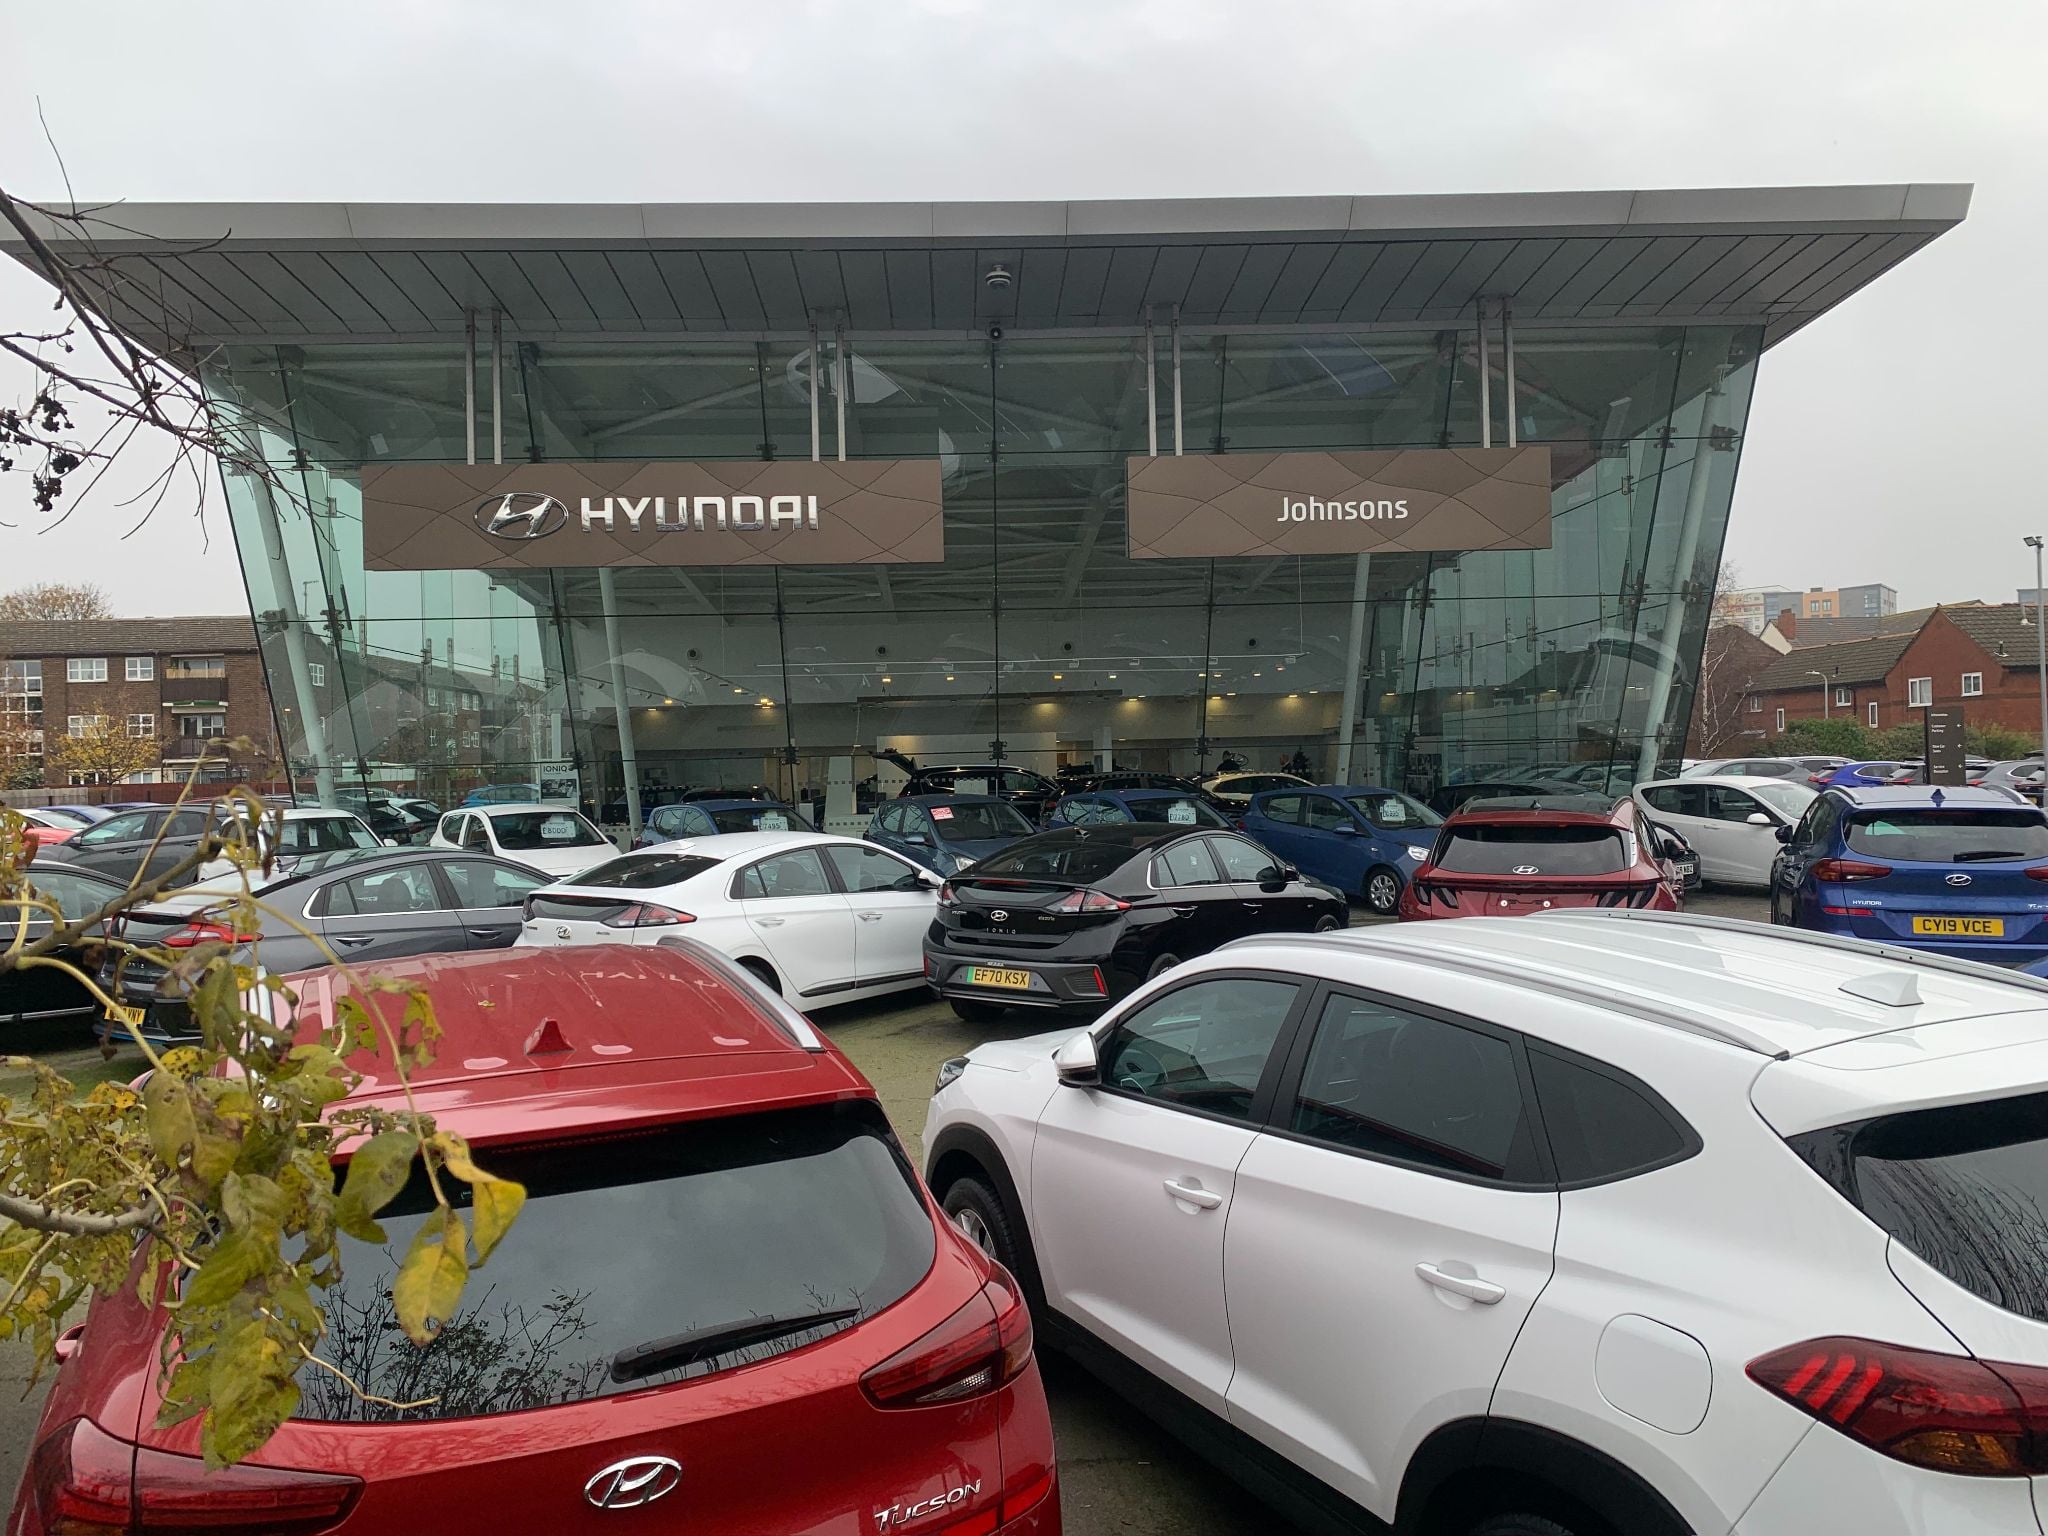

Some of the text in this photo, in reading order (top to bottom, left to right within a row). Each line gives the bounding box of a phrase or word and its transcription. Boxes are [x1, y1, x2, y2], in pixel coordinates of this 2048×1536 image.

[580, 495, 818, 533] HYUNDAI
[1277, 496, 1409, 522] Johnsons
[543, 765, 568, 773] IONIQ
[986, 927, 1017, 935] IONIQ
[1922, 918, 1993, 934] CY19 VCE
[974, 968, 1028, 986] EF70 KSX
[874, 1478, 982, 1532] TUCSON
